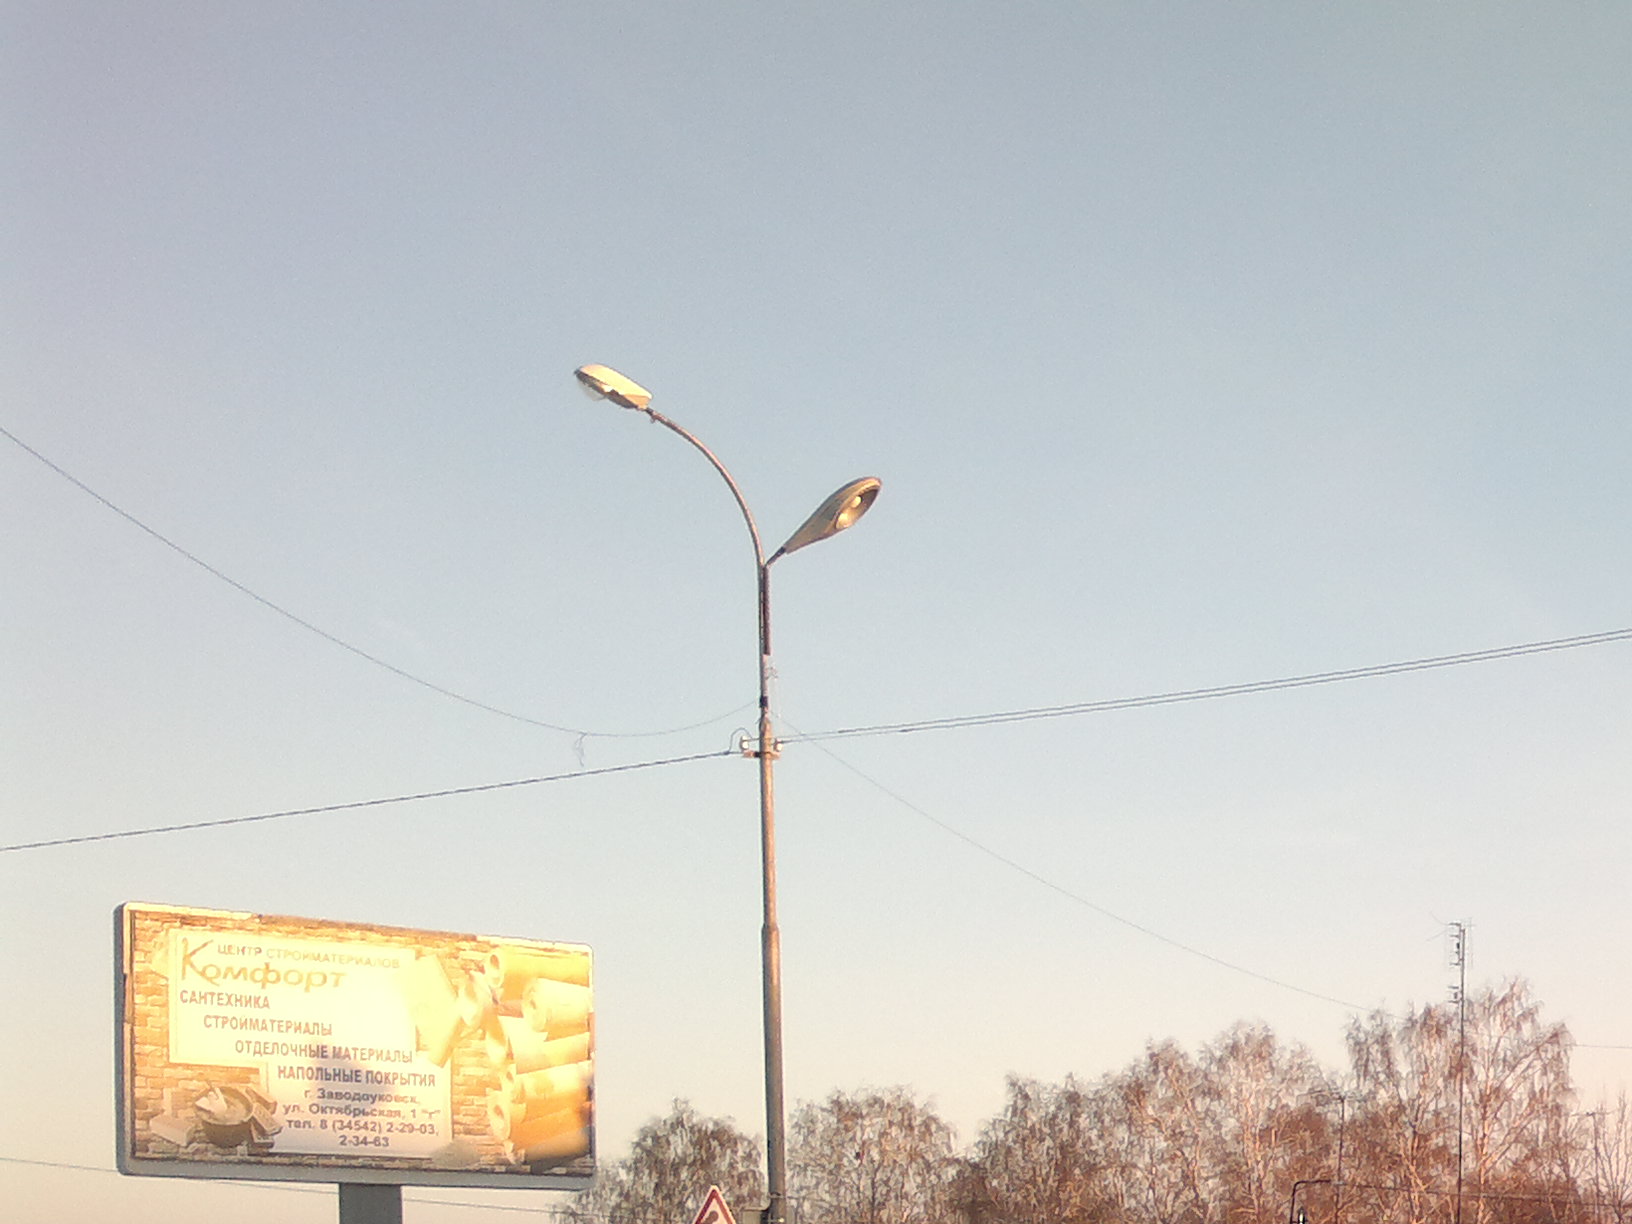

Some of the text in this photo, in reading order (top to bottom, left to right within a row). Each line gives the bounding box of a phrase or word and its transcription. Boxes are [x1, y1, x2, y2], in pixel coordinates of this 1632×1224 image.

[217, 944, 263, 956] ЦЕНТР
[181, 937, 347, 993] Комфорт
[179, 989, 271, 1009] САНТЕХНИКА
[203, 1014, 333, 1036] СТРОЙМАТЕРИАЛЫ
[235, 1040, 413, 1063] ОТДЕЛОЧНЫЕ МАТЕРИАЛЫ
[277, 1065, 436, 1087] НАПОЛЬНЫЕ ПОКРЫТИЯ
[410, 1108, 417, 1119] 1
[286, 1118, 315, 1130] тел.
[319, 1118, 329, 1130] 8
[332, 1119, 382, 1134] (34542)
[338, 1134, 390, 1148] 2-34-63
